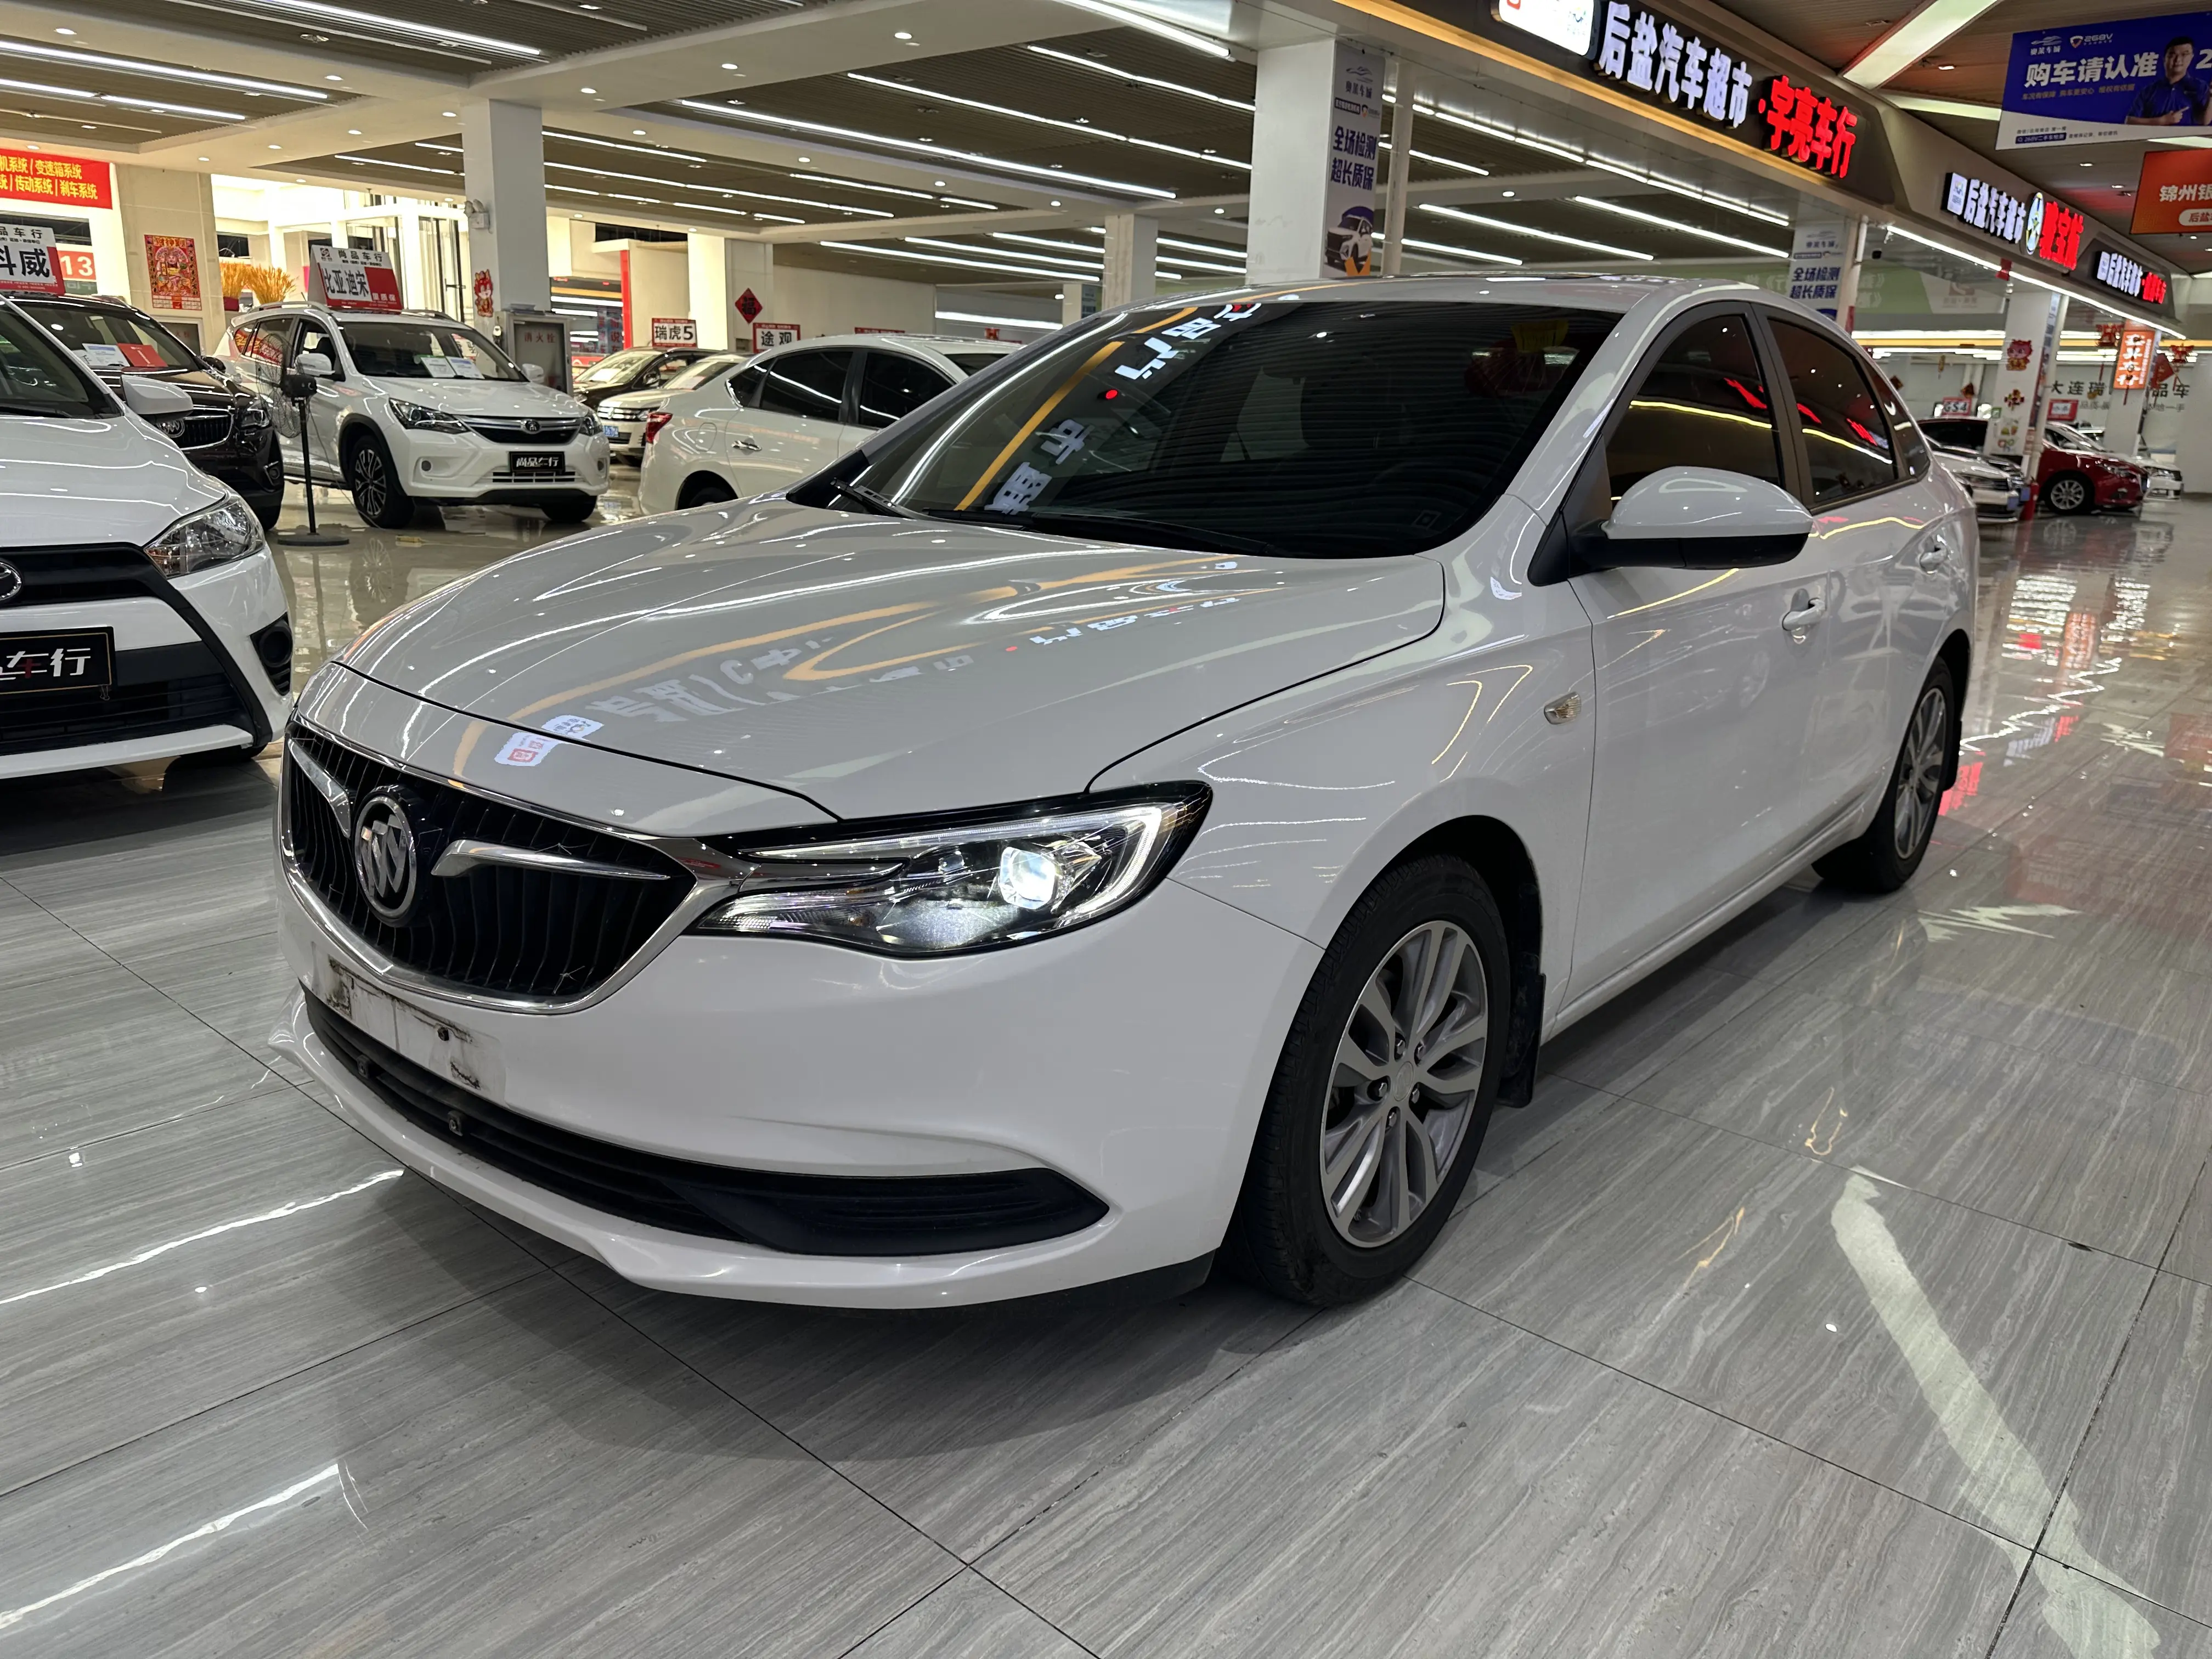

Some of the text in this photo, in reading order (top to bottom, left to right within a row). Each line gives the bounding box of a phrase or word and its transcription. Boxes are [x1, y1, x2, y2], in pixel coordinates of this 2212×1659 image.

[1599, 1, 1752, 128] 后盐汽车超市
[2024, 52, 2159, 88] 购车请认准
[1333, 126, 1378, 160] 全场检测
[1331, 157, 1375, 191] 超长质保
[2159, 183, 2212, 202] 锦州银
[1963, 178, 2026, 244] 后盐汽车超市
[2188, 212, 2212, 223] 后盐
[60, 255, 93, 276] 13
[338, 250, 382, 262] 尚品车行
[321, 268, 369, 297] 比亚迪宋
[1791, 267, 1841, 283] 全场检测
[1790, 285, 1837, 299] 超长质保
[742, 296, 757, 315] 福
[524, 331, 556, 344] 消火栓
[654, 326, 693, 341] 瑞虎5
[761, 331, 792, 347] 途观
[0, 648, 92, 681] 车行
